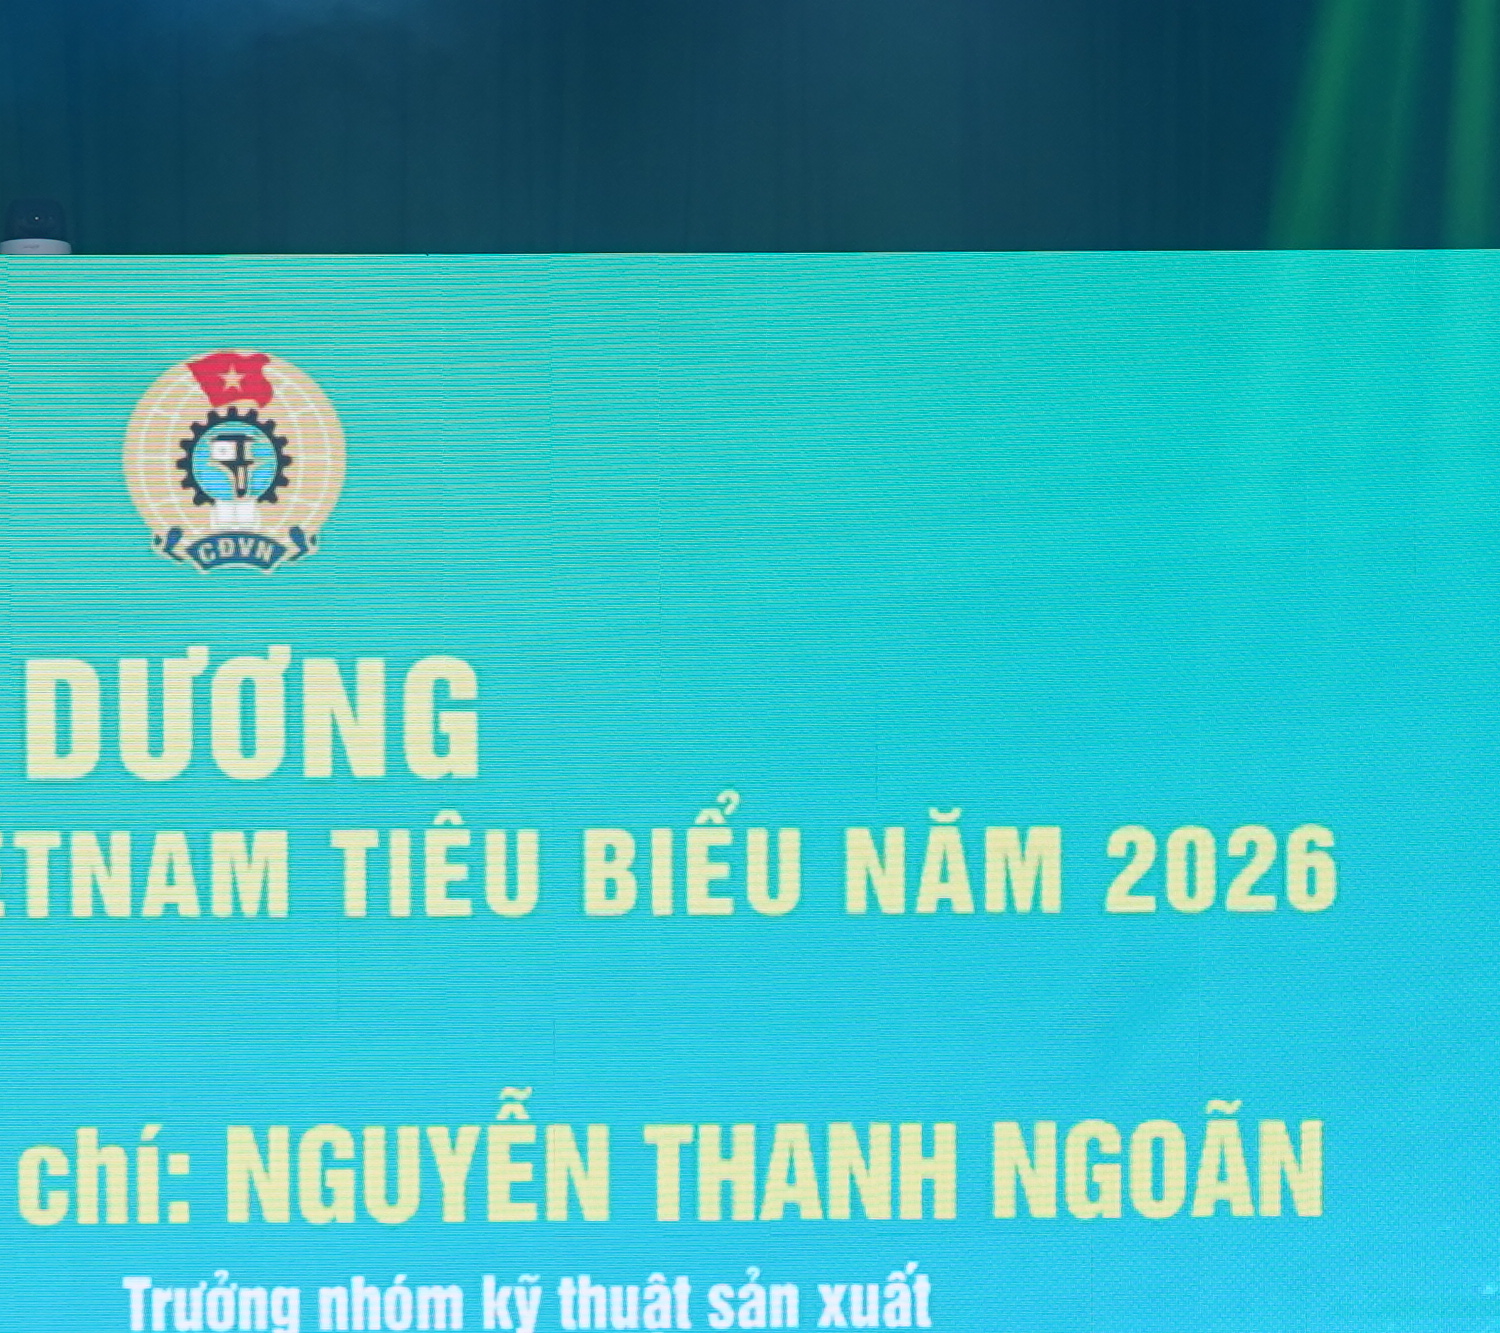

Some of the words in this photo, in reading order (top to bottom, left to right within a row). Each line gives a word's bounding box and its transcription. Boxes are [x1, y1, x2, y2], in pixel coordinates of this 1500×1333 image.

[26, 644, 478, 781] DƯƠNG
[331, 810, 538, 917] TIÊU
[585, 786, 800, 917] BIỂU
[846, 810, 1061, 914] NĂM
[1107, 825, 1336, 912] 2026
[18, 1123, 190, 1227] chí:
[227, 1086, 609, 1225] NGUYỄN
[643, 1122, 956, 1223] THANH
[994, 1099, 1322, 1220] NGOÃN
[319, 1275, 463, 1332] nhóm
[708, 1265, 798, 1330] sản
[819, 1262, 931, 1329] xuất
